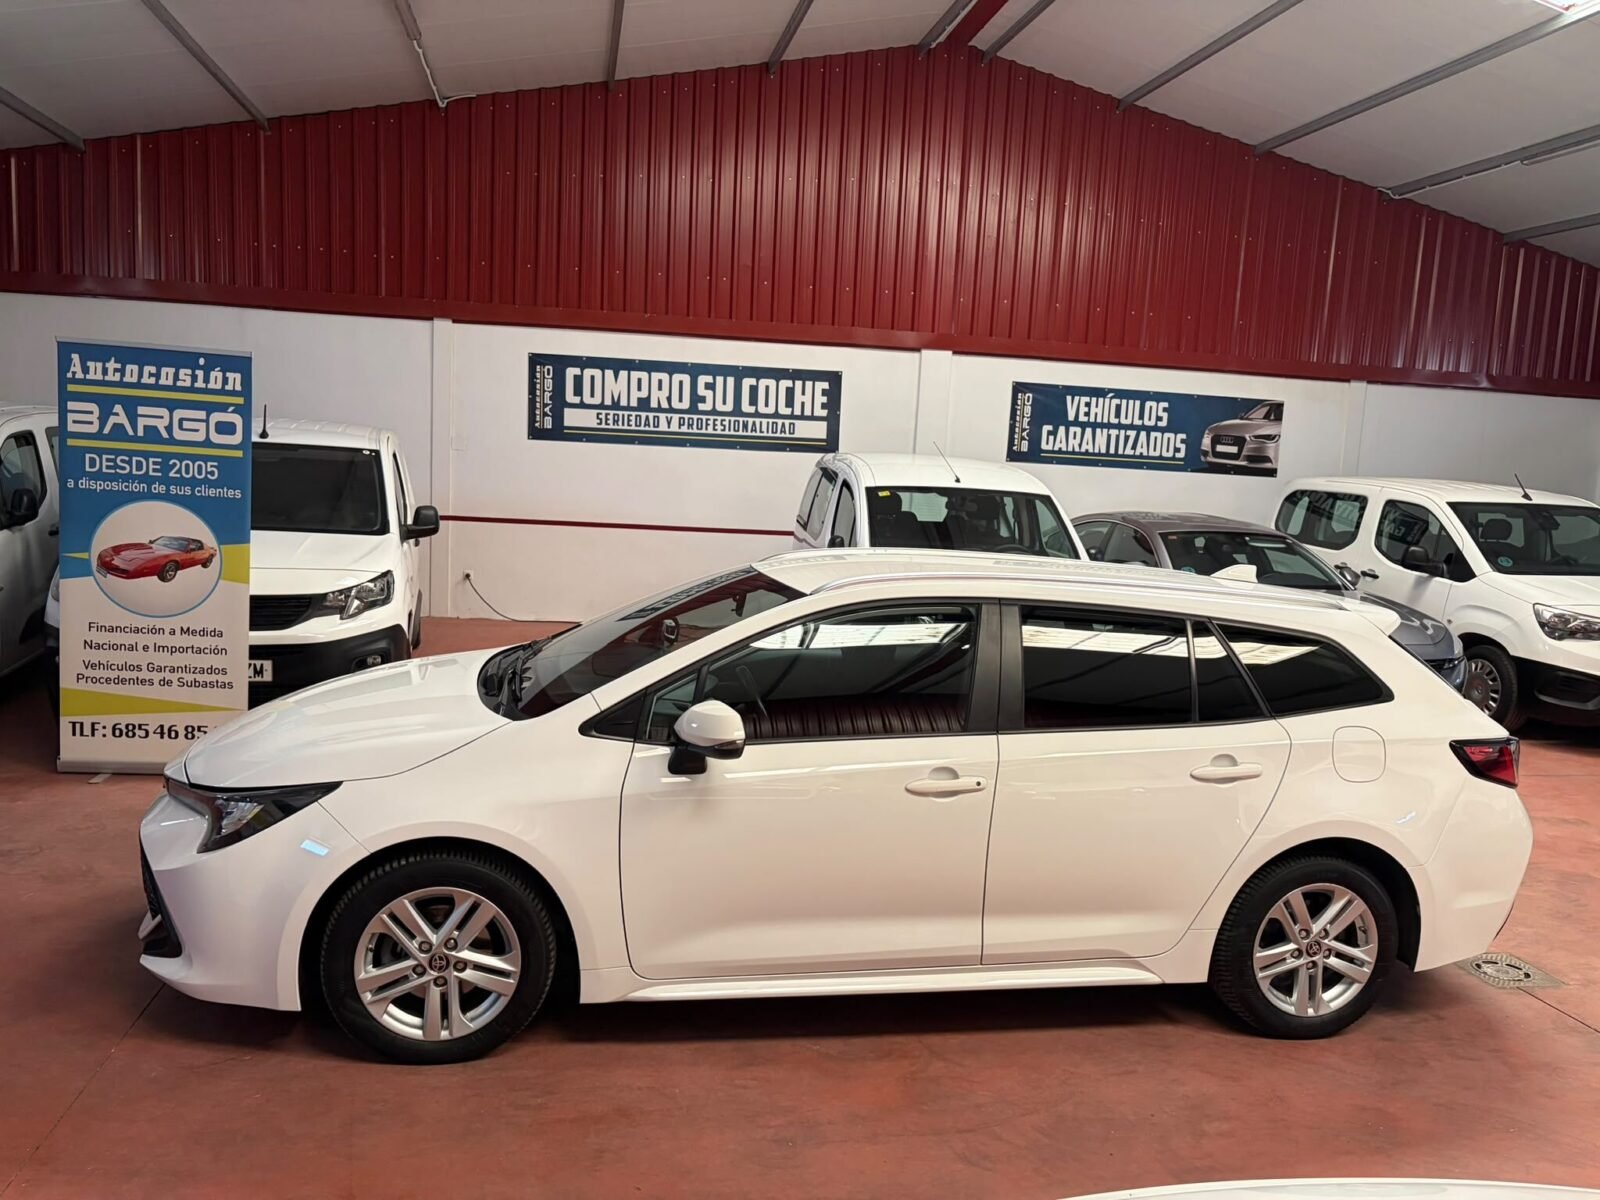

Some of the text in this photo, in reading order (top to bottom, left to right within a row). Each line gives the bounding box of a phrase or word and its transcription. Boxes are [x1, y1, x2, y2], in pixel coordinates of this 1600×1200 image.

[66, 353, 242, 391] Autocasión
[565, 366, 830, 417] COMPRO SU COCHE
[1065, 393, 1169, 427] VEHÍCULOS
[67, 400, 243, 445] BARGÓ
[596, 411, 796, 435] SERIEDAD Y PROFESIONALIDAD
[1040, 425, 1187, 459] GARANTIZADOS
[85, 453, 219, 480] DESDE 2005
[67, 477, 242, 498] a disposición de sus clientes
[88, 622, 223, 638] Financiación a Medida
[83, 639, 228, 656] Nacional e Importación
[82, 659, 228, 676] Vehículos Garantizados
[76, 673, 234, 690] Procedentes de Subastas
[68, 721, 107, 738] TLF:
[111, 722, 149, 739] 685
[152, 724, 179, 740] 46
